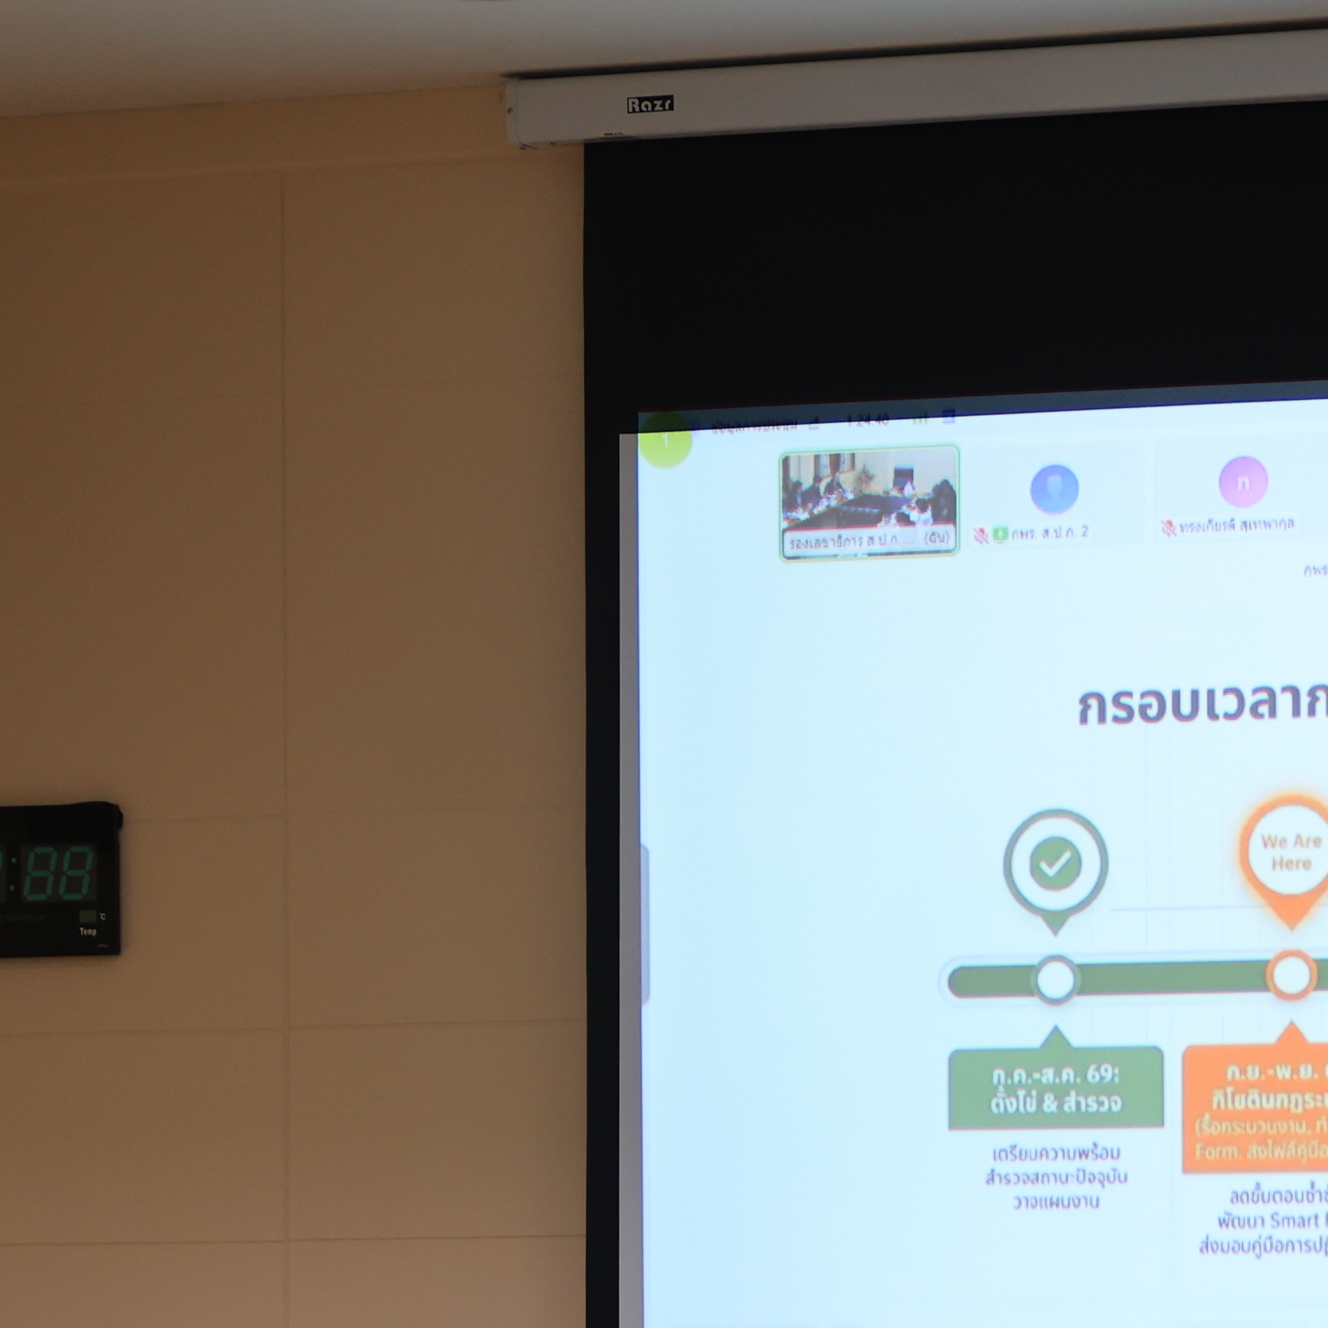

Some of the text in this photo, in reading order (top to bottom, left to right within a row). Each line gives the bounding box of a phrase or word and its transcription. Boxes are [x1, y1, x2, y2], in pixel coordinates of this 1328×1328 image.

[628, 98, 672, 113] Razr
[1081, 524, 1090, 538] 2
[1261, 831, 1323, 851] We Are
[1271, 854, 1313, 874] Here
[79, 927, 97, 937] Temp
[1087, 1063, 1120, 1083] 69:
[1043, 1094, 1058, 1112] &
[1063, 1087, 1123, 1113] สำรวจ
[992, 1140, 1121, 1162] เตรียมความพร้อม
[985, 1163, 1128, 1189] สำรวจสถานะปัจจุบัน
[1013, 1192, 1100, 1210] วางแผนงาน
[1217, 1210, 1266, 1230] พัฒนา
[1270, 1211, 1320, 1229] Smart
